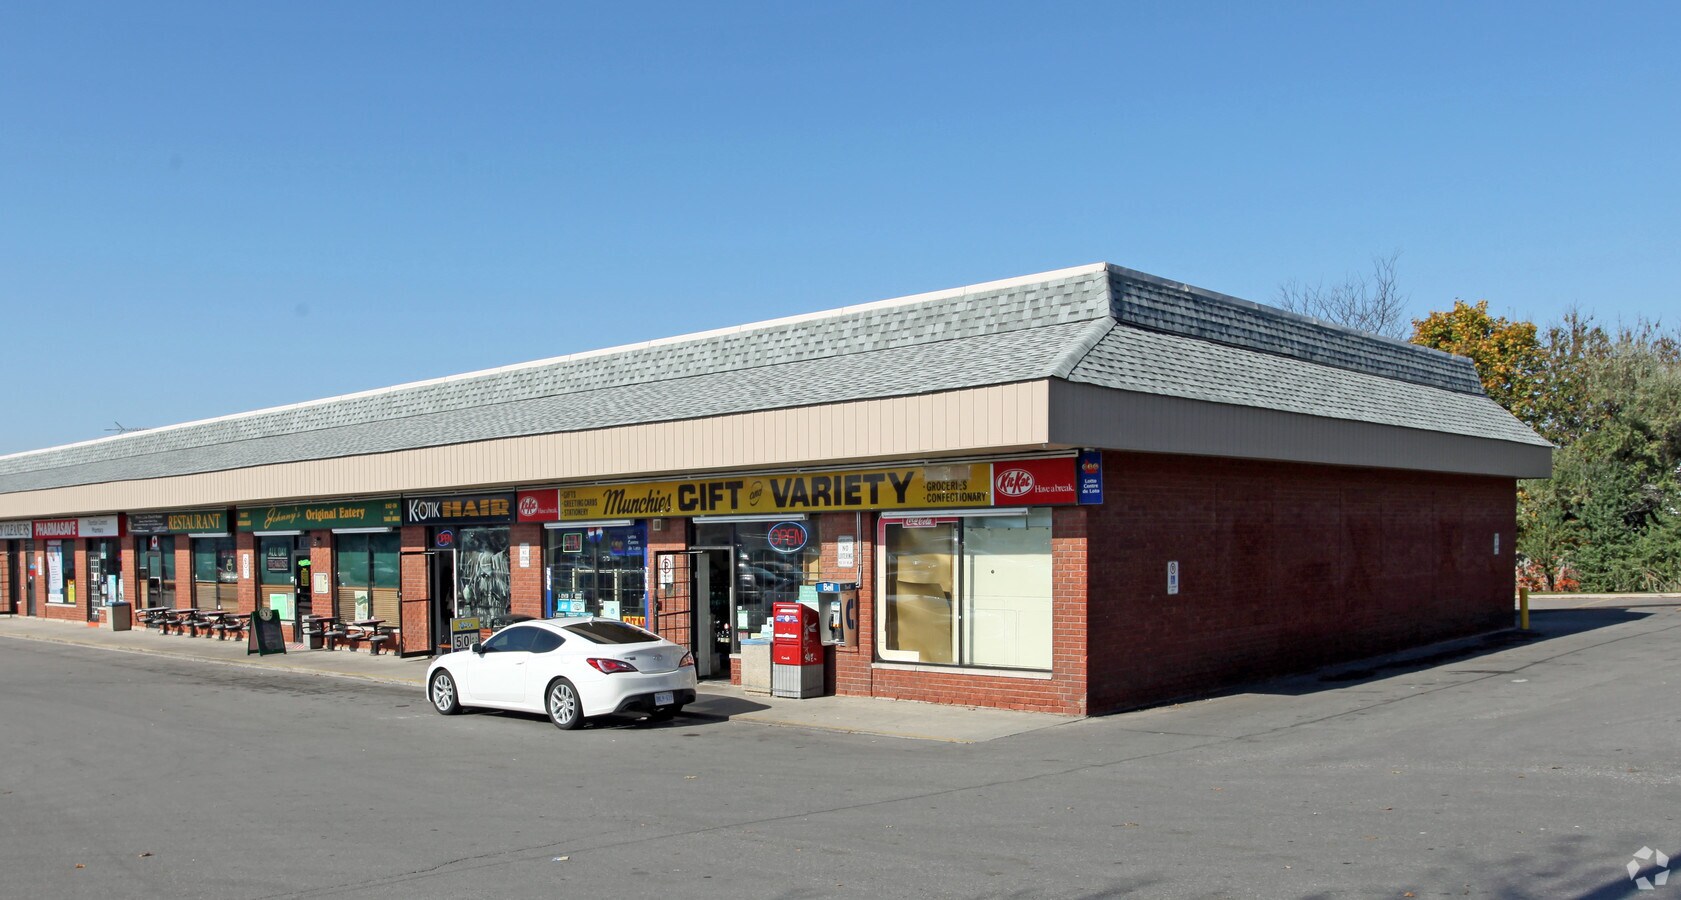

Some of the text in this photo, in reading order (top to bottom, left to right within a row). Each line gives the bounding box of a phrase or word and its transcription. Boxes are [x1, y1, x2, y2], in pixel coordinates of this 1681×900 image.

[602, 488, 671, 515] Munchies
[678, 481, 744, 511] GIFT
[770, 472, 915, 507] VARIETY
[927, 492, 987, 502] CONFECTIONARY
[1034, 485, 1050, 493] Have
[442, 499, 509, 518] HAIR
[168, 513, 221, 531] RESTAURANT
[264, 506, 366, 529] Johnny's Original Eatery
[36, 521, 76, 537] PHARMASAVE
[770, 529, 803, 546] OPEN
[823, 583, 834, 592] Bell
